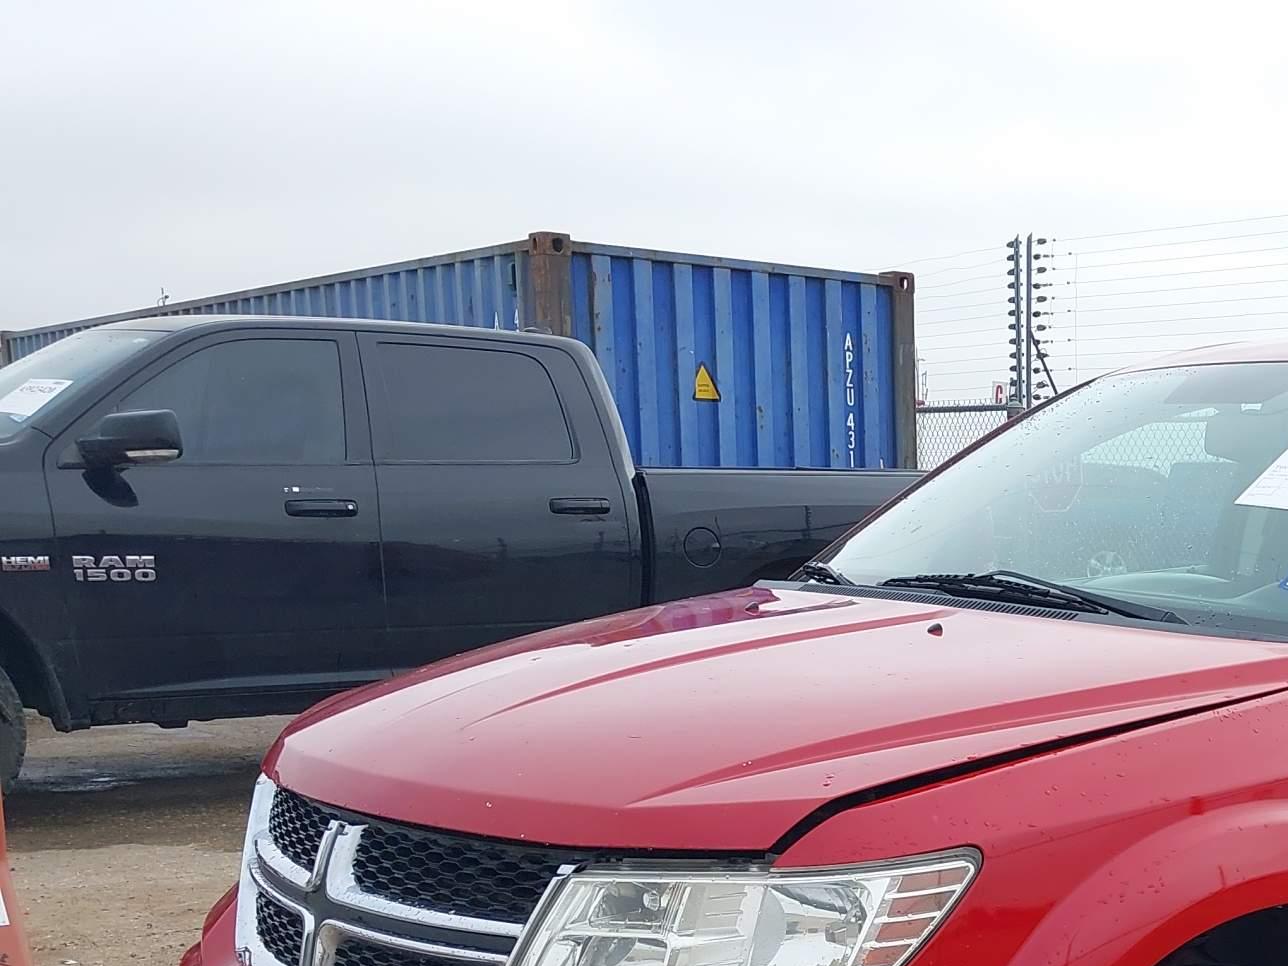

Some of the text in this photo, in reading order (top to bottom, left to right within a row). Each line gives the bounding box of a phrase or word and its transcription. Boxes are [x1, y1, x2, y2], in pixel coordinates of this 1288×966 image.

[844, 332, 855, 406] APZU
[1, 555, 49, 565] HEMI
[72, 555, 155, 568] RAM
[73, 568, 157, 582] 1500
